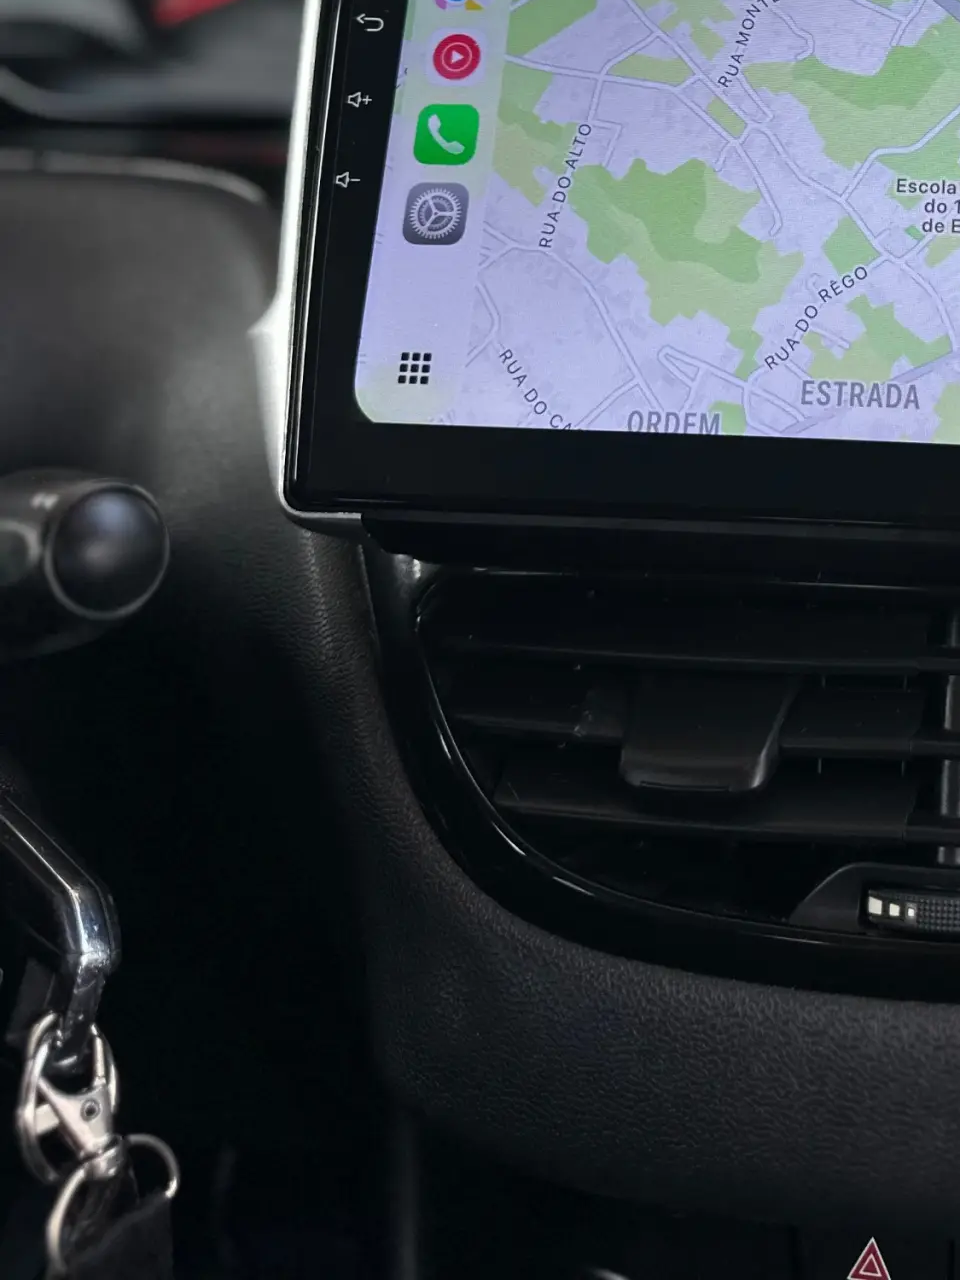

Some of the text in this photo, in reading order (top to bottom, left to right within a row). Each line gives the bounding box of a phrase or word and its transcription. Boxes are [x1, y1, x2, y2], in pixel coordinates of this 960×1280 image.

[717, 52, 744, 88] RUA
[539, 124, 591, 248] RUA DO ALTO
[896, 178, 957, 195] Escola
[924, 198, 947, 214] do
[922, 219, 945, 233] de
[764, 266, 868, 370] RUA DO RÊGO
[499, 349, 528, 387] RUA
[524, 388, 548, 415] DO
[800, 379, 920, 410] ESTRADA
